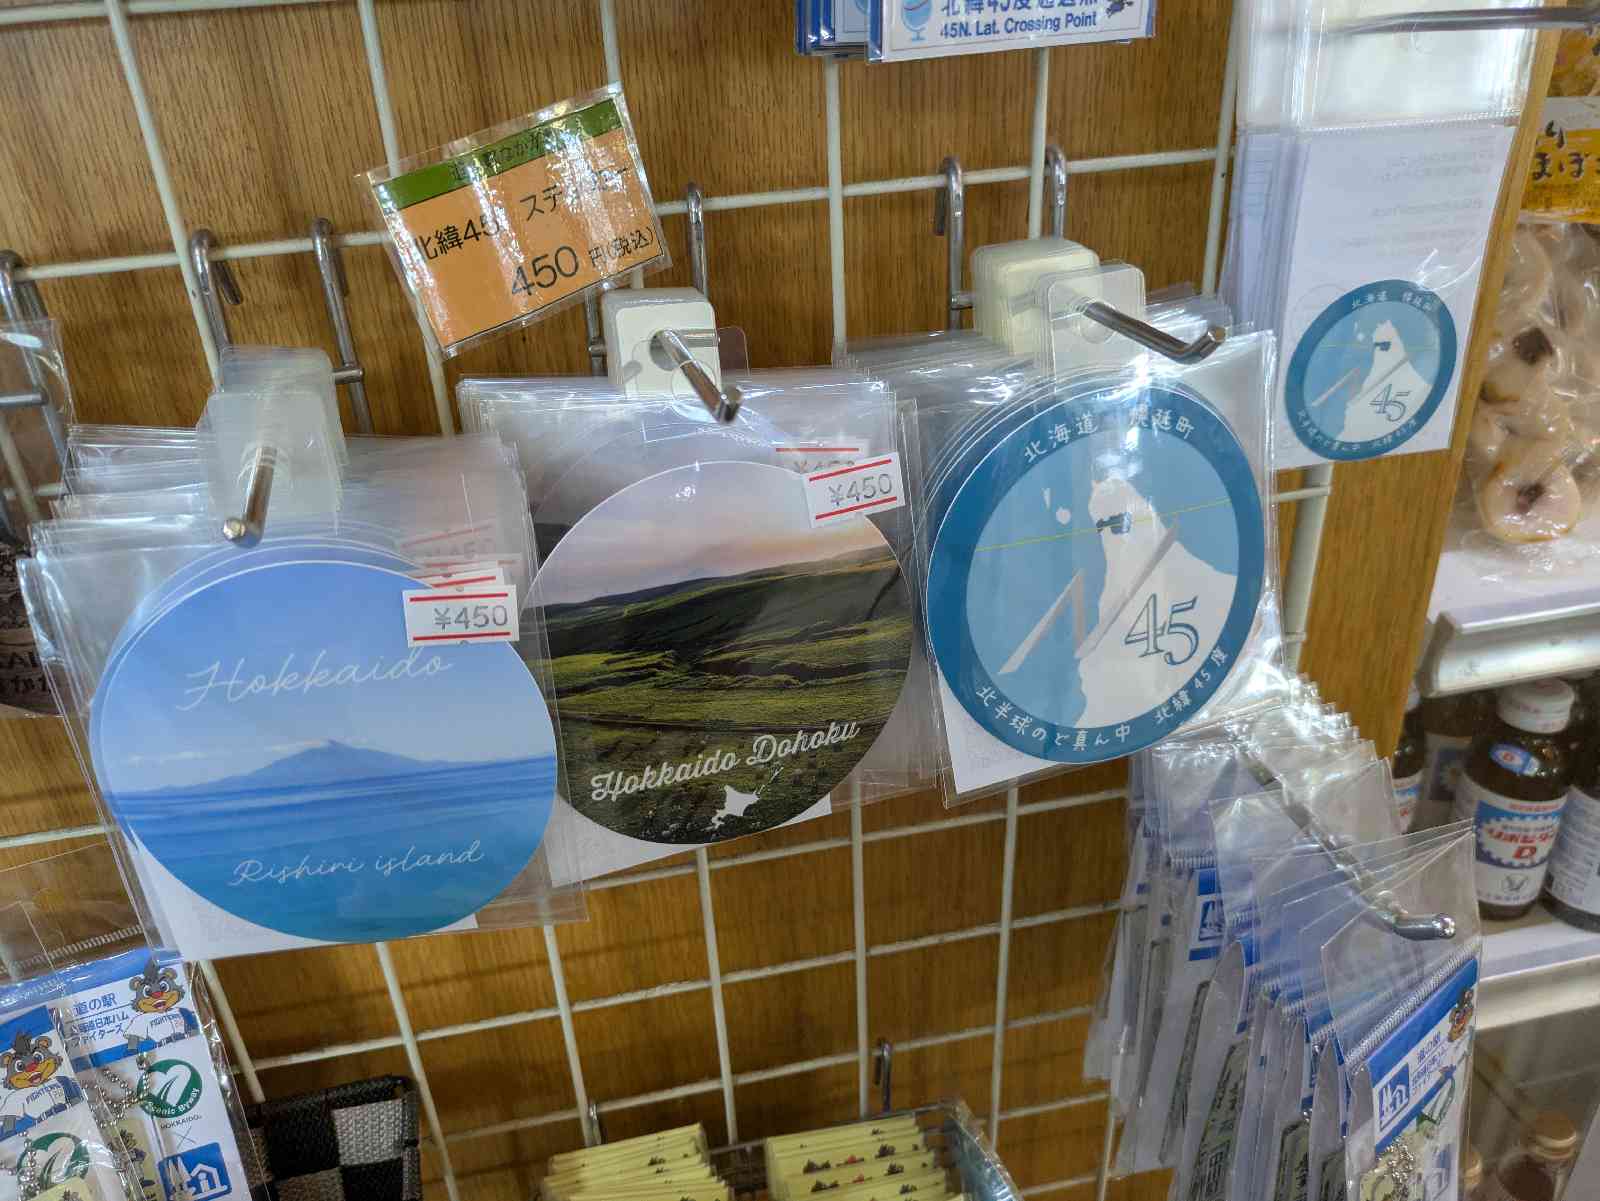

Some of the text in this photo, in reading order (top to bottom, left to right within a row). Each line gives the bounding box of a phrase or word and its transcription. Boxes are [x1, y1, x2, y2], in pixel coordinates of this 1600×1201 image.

[940, 12, 1097, 39] 45N. Lat. Crossing Point
[511, 246, 580, 297] 450
[1368, 383, 1412, 422] 45
[1023, 411, 1099, 462] 北海道
[828, 473, 892, 507] ¥450
[434, 605, 509, 632] ¥450
[1124, 592, 1200, 667] 45
[176, 647, 453, 711] Hokkaido
[590, 721, 861, 802] Hokkaido Dohoku
[227, 840, 485, 887] Rishiri island
